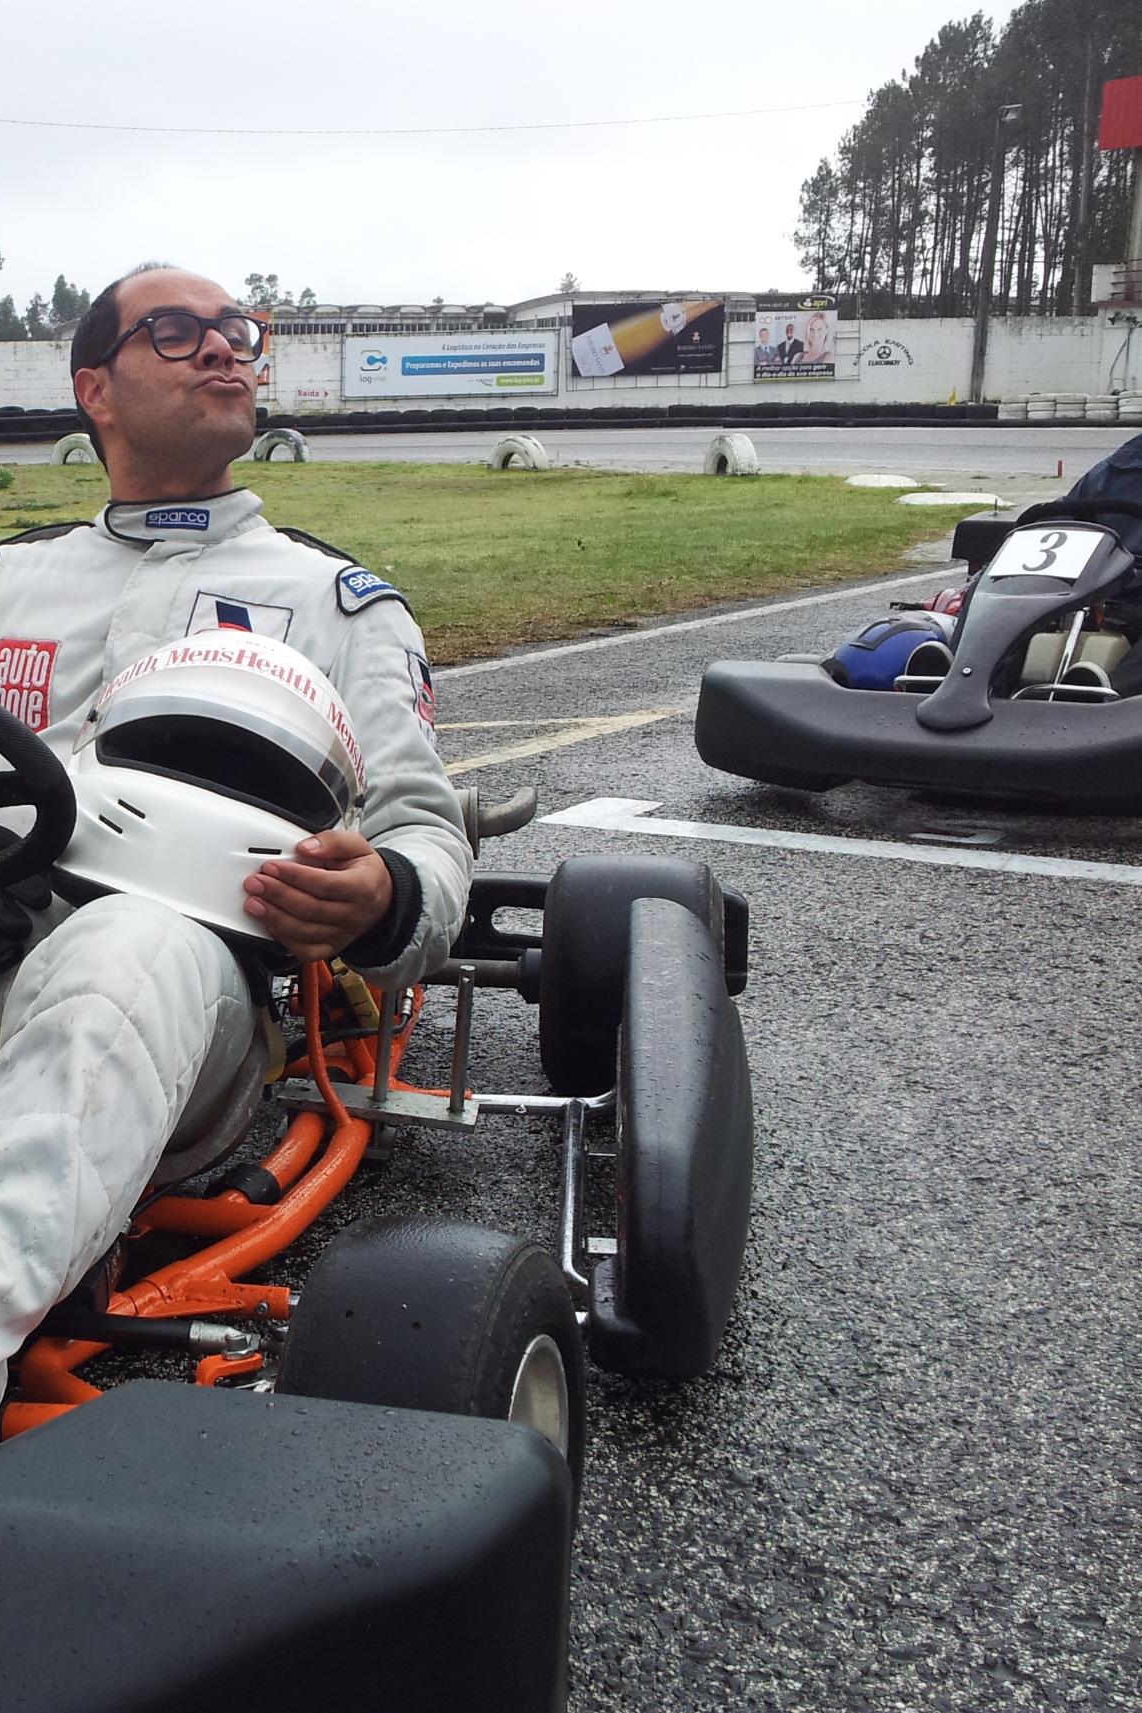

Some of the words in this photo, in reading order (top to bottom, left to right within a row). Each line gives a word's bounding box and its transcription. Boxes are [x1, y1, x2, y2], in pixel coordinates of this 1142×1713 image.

[885, 339, 914, 365] KARTING
[148, 511, 207, 525] sparco
[1022, 531, 1068, 572] 3
